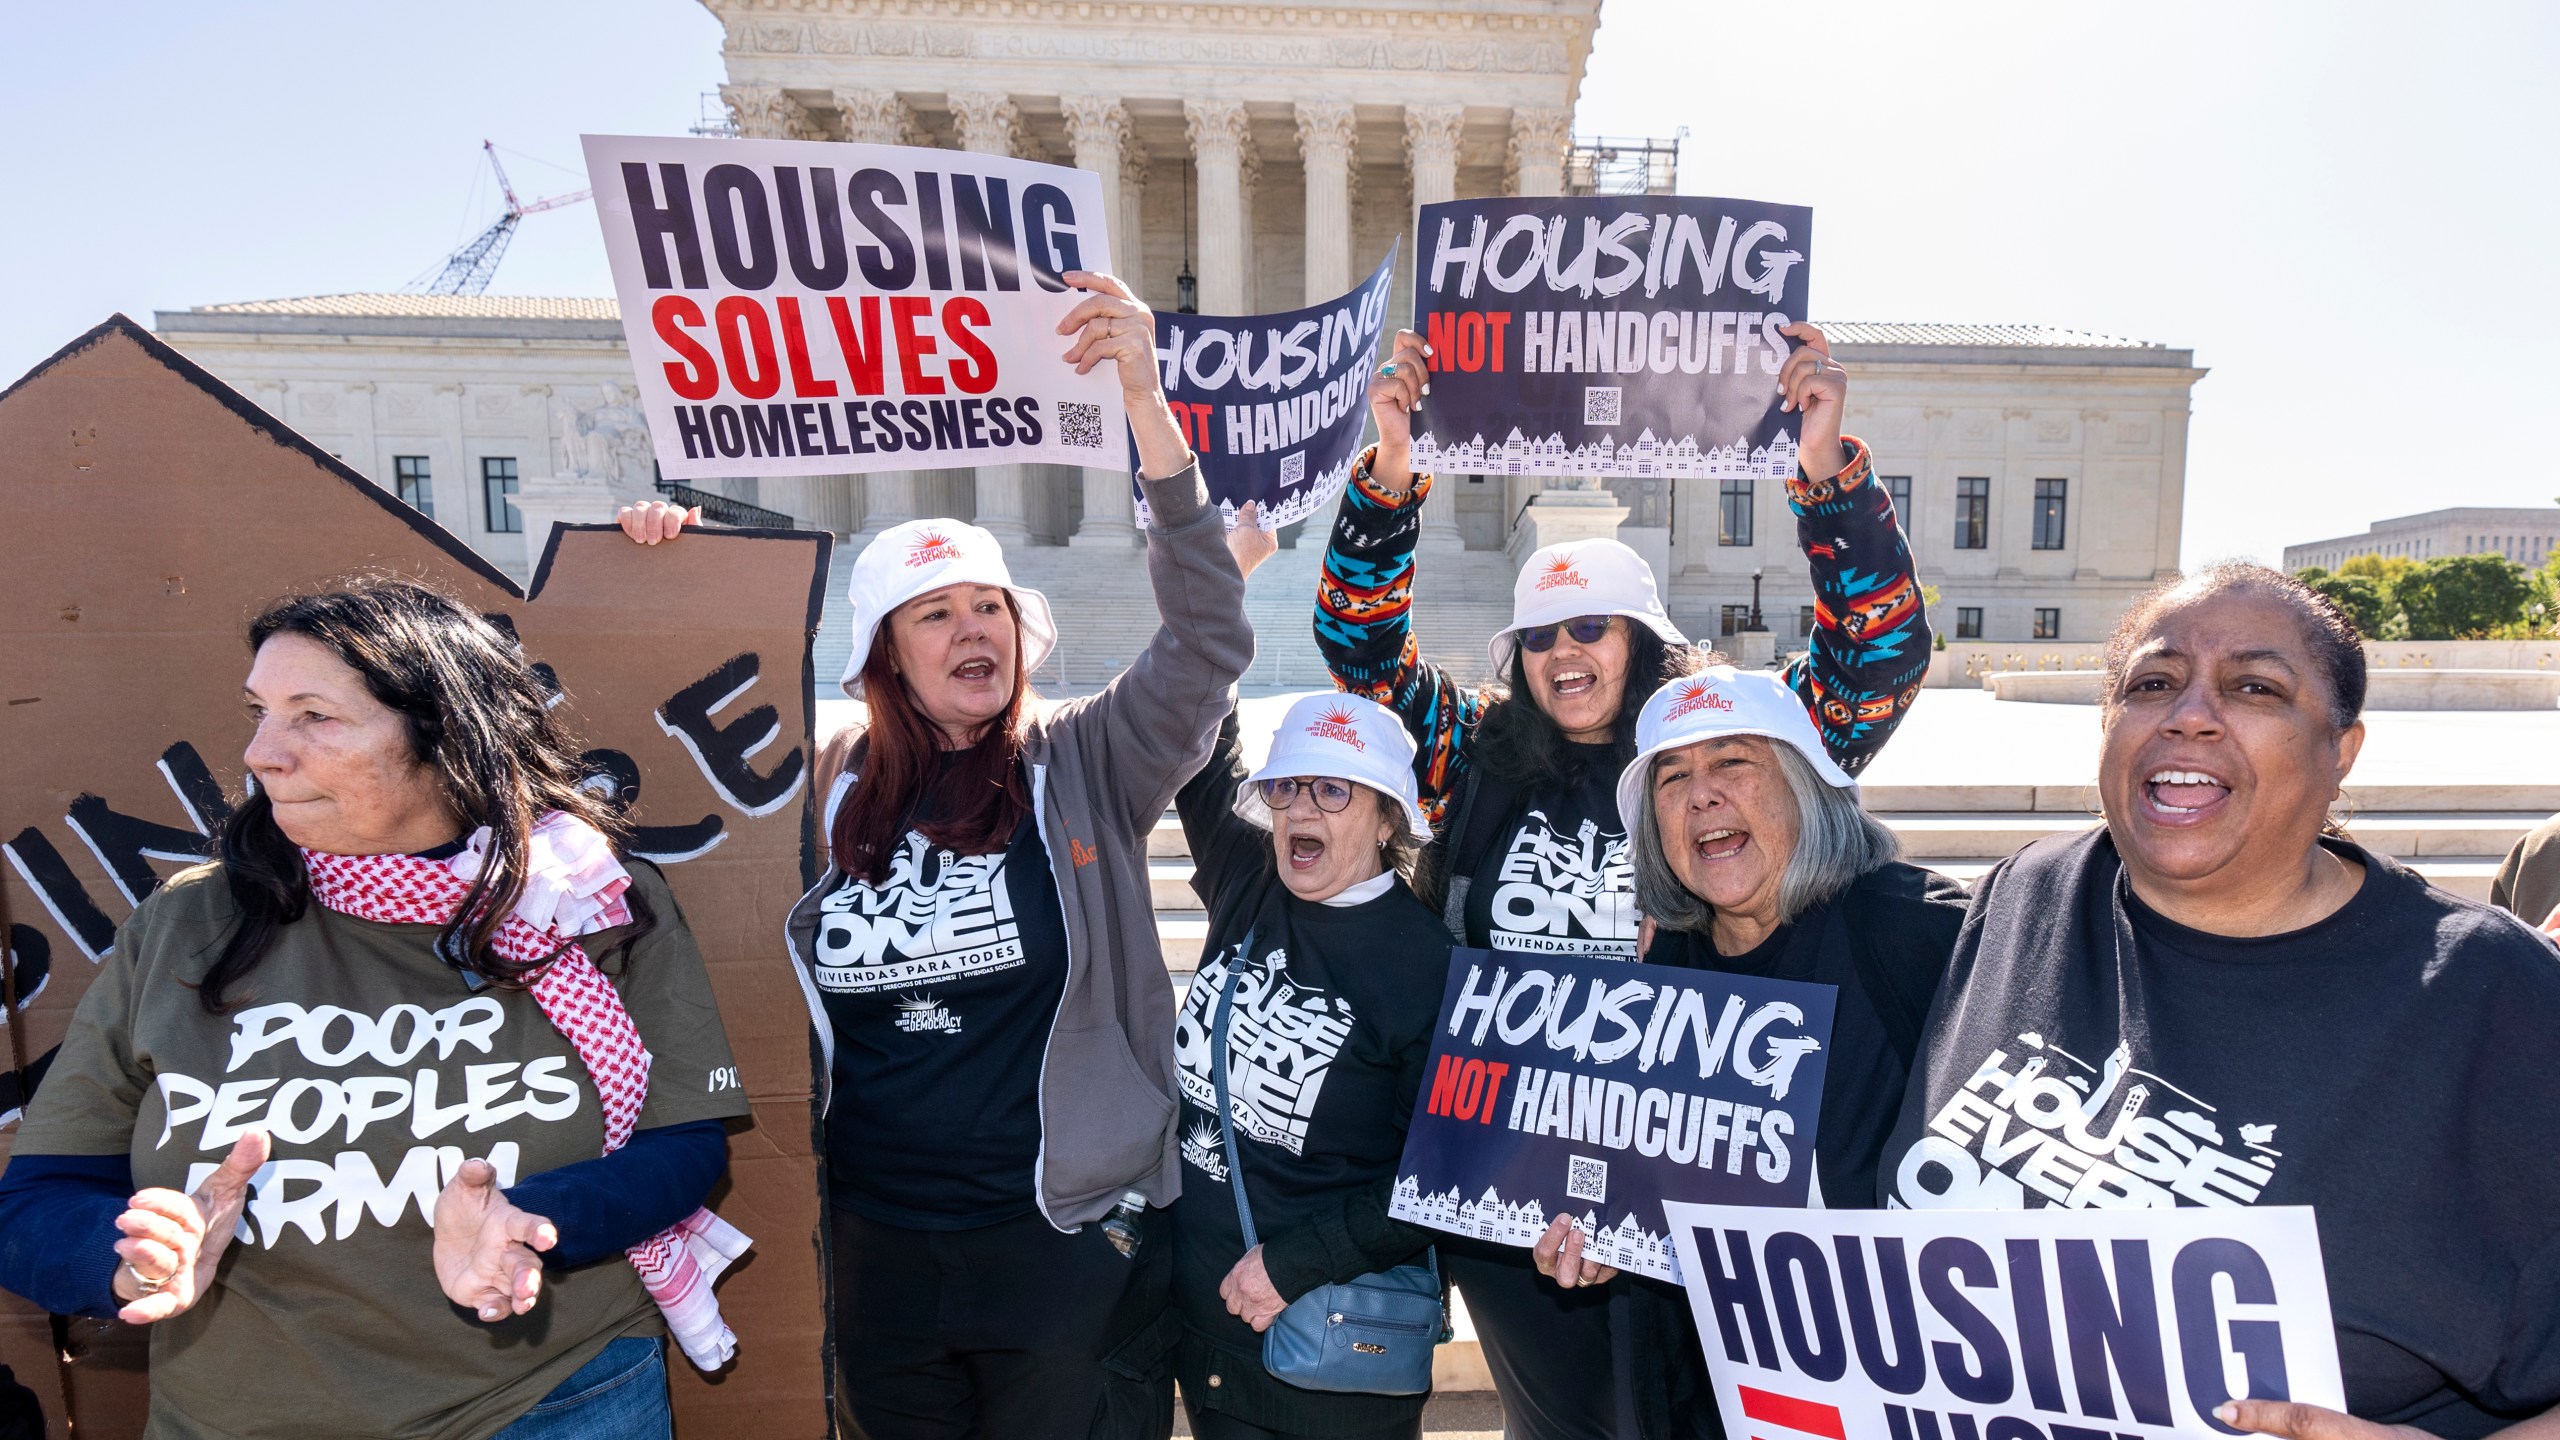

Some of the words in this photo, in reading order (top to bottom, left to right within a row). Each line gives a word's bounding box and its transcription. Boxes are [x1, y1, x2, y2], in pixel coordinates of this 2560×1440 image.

[992, 35, 1067, 56] EQUAL
[1079, 37, 1169, 58] JUSTICE
[1180, 40, 1260, 60] UNDER
[1265, 43, 1311, 62] LAW
[620, 161, 1088, 294] HOUSING
[1430, 211, 1804, 305] HOUSING
[650, 295, 999, 401] SOLVES
[1427, 310, 1511, 373] NOT
[1523, 310, 1792, 374] HANDCUFFS
[673, 395, 1043, 460] HOMELESSNESS
[1168, 400, 1214, 454] OT
[1545, 576, 1589, 590] DEMOCRACY
[1546, 570, 1579, 582] POPULAR
[1677, 699, 1734, 717] DEMOCRACY
[1678, 693, 1720, 709] POPULAR
[1320, 729, 1366, 751] DEMOCRACY
[1321, 721, 1358, 738] POPULAR
[1492, 933, 1576, 952] VIVIENDAS
[1583, 942, 1625, 952] PARA
[816, 967, 899, 983] VIVIENDAS
[905, 959, 952, 975] PARA
[958, 945, 1015, 967] TODES
[963, 966, 995, 978] VIVIENDAS
[994, 958, 1027, 972] SOCIALES!
[901, 1011, 910, 1019] THE
[910, 1007, 949, 1021] POPULAR
[1199, 949, 1352, 1059] HOUSE
[225, 996, 505, 1073] POOR
[909, 1015, 962, 1032] DEMOCRACY
[1448, 964, 1822, 1101] HOUSING
[708, 1065, 742, 1093] 191
[155, 1055, 580, 1152] PEOPLES
[1252, 1119, 1298, 1146] TODES
[1426, 1054, 1509, 1125] NOT
[1507, 1065, 1795, 1184] HANDCUFFS
[1964, 1044, 2274, 1208] HOUSE
[1187, 1151, 1230, 1178] DEMOCRACY
[1190, 1141, 1221, 1164] POPULAR
[1691, 1225, 2291, 1437] HOUSING
